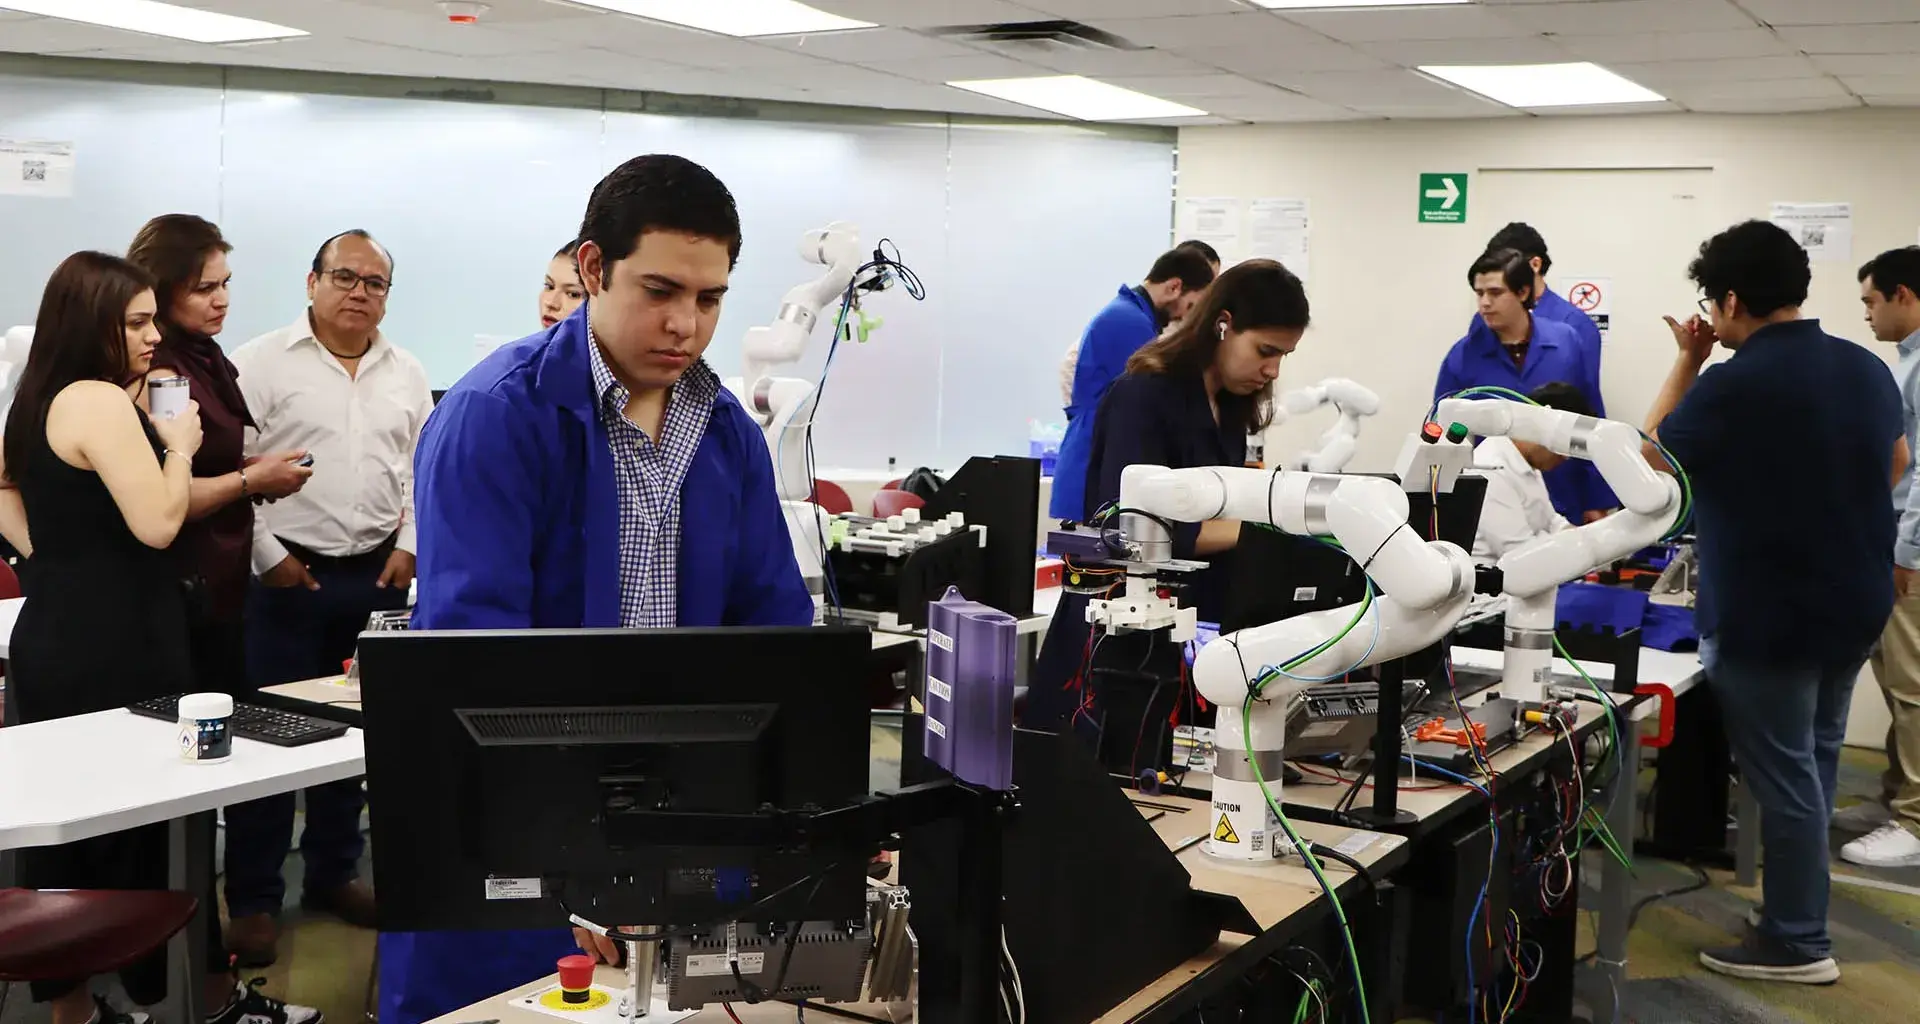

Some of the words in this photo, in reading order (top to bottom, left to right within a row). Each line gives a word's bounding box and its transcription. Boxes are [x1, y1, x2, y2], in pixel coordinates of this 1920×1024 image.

[931, 629, 951, 649] OPERATE
[929, 678, 949, 697] CAUTION
[928, 718, 944, 736] DANGER
[1213, 800, 1241, 812] CAUTION
